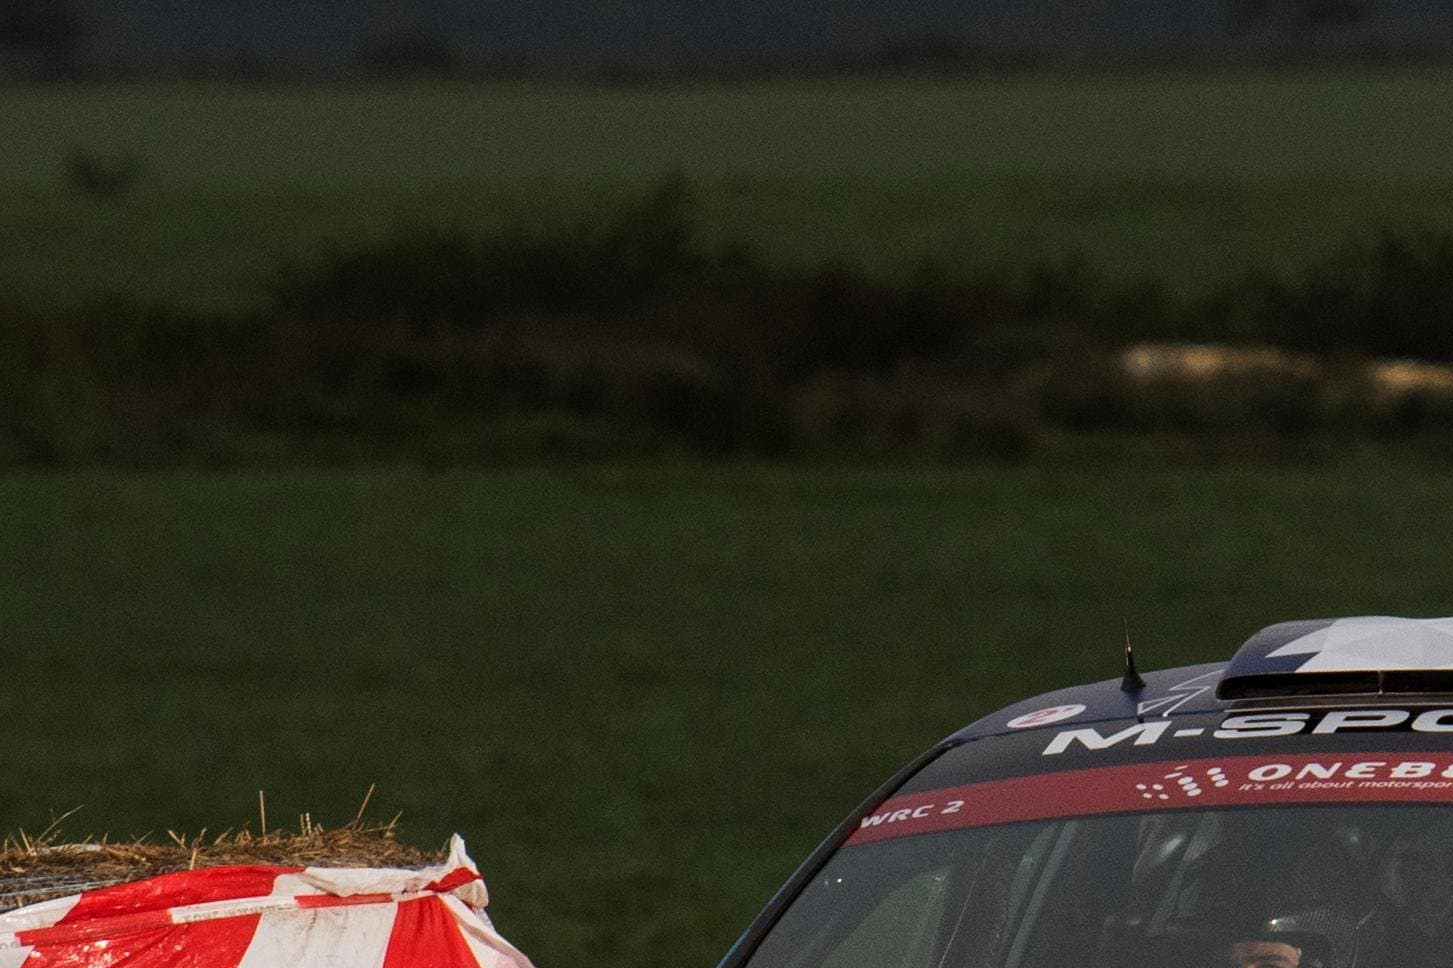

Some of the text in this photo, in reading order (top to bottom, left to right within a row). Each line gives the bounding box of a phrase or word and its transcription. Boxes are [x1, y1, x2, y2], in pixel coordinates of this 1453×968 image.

[1270, 780, 1293, 790] all
[1299, 780, 1353, 790] about
[858, 801, 965, 829] WRC 2
